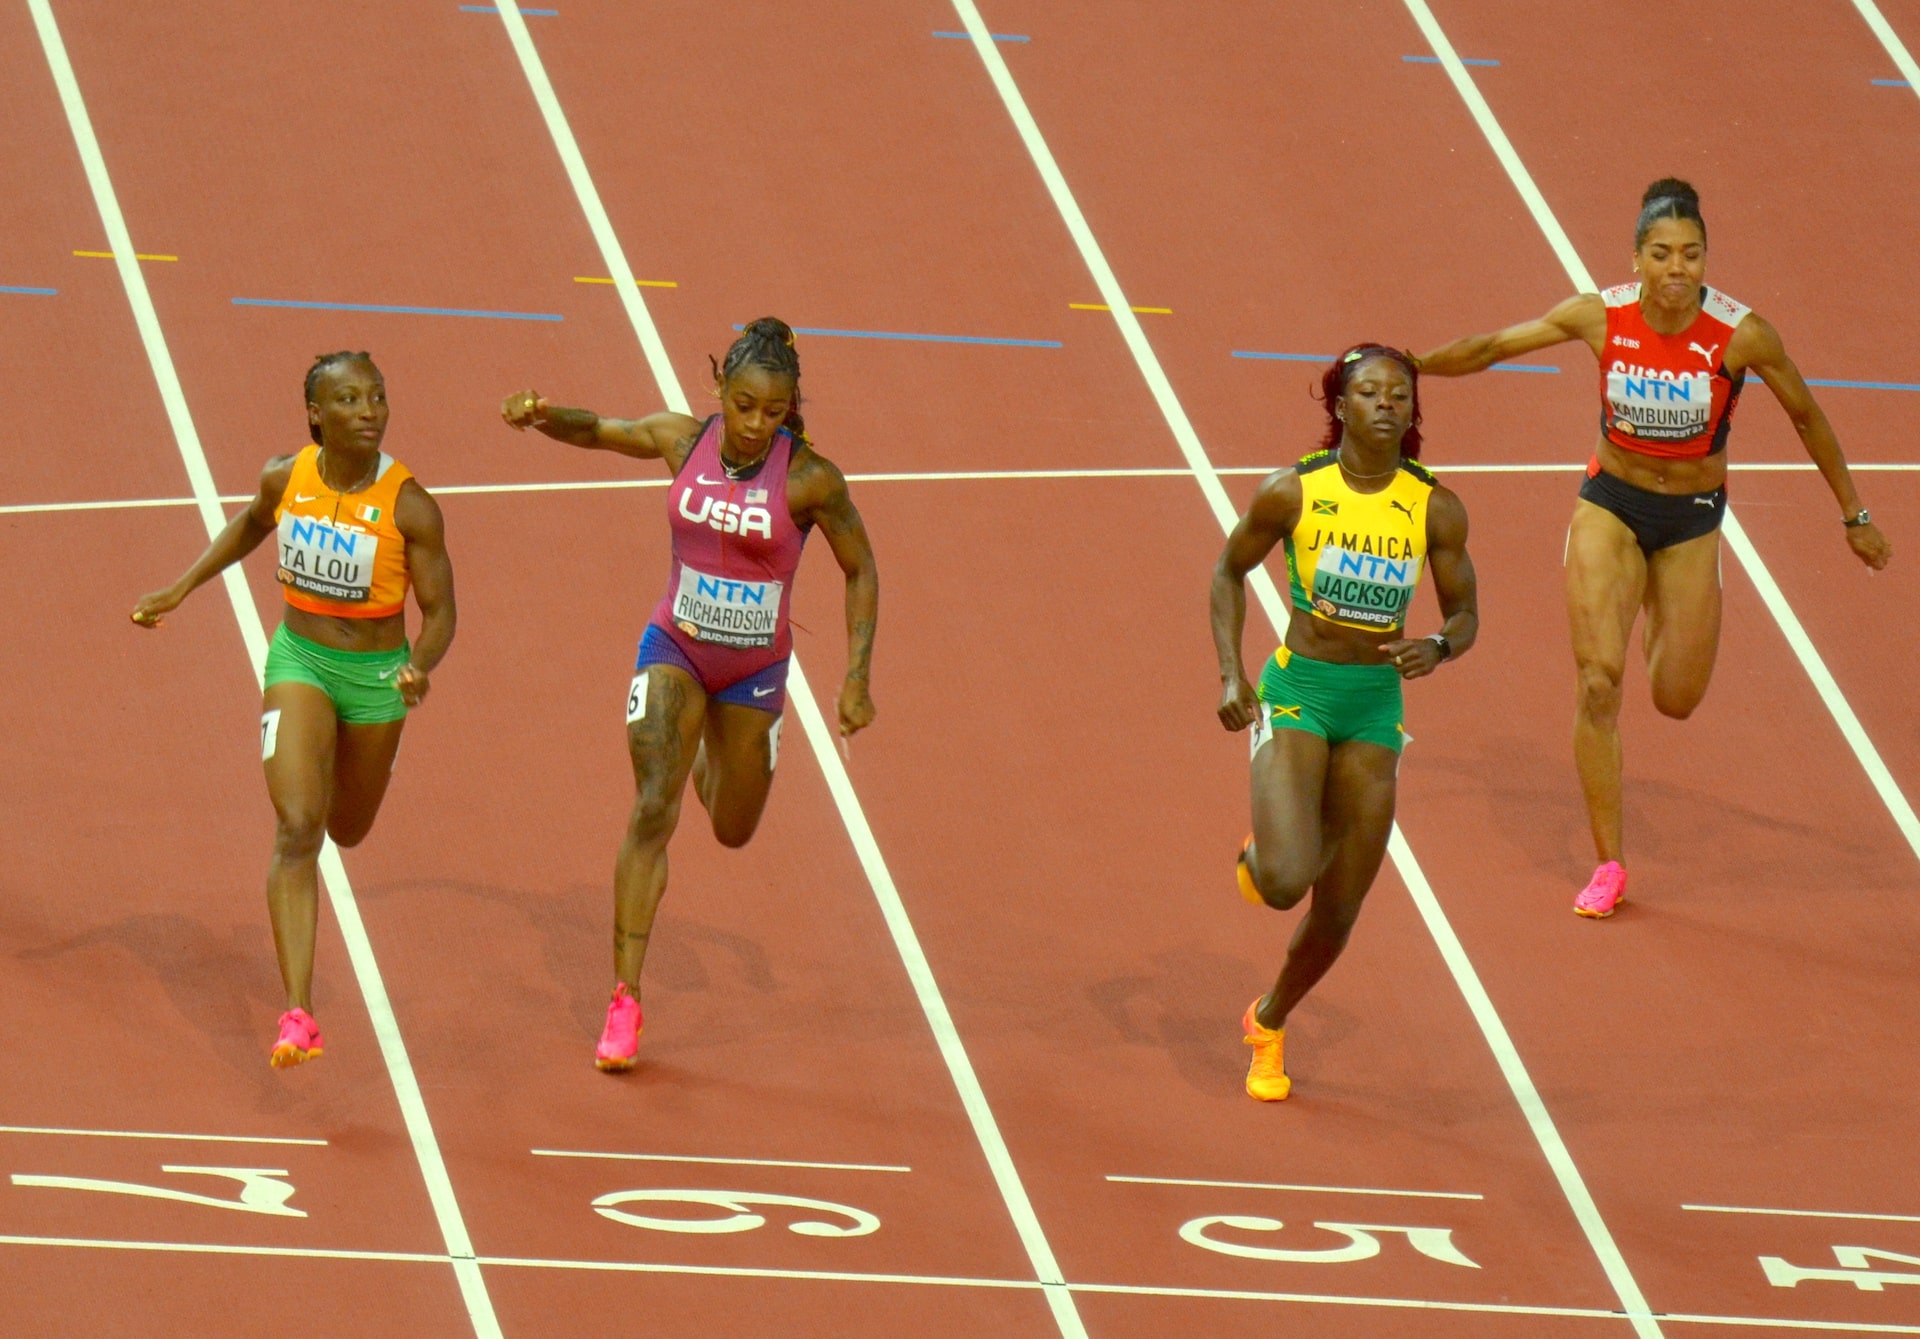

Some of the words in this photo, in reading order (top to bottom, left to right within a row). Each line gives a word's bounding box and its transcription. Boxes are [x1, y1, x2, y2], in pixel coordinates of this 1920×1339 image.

[1622, 338, 1641, 350] UBS
[1625, 376, 1691, 402] NTN
[1612, 400, 1705, 425] KAMBUNDJI
[1637, 426, 1692, 438] BUDAPEST
[678, 487, 772, 540] USA
[291, 518, 357, 558] NTN
[1308, 529, 1413, 561] JAMAICA
[283, 543, 306, 572] TA
[314, 555, 359, 584] LOU
[1338, 551, 1407, 584] NTN
[295, 576, 350, 598] BUDAPEST
[350, 588, 364, 599] 23
[697, 575, 766, 605] NTN
[1318, 575, 1410, 609] JACKSON
[678, 594, 774, 631] RICHARDSON
[1338, 608, 1394, 624] BUDAPEST
[700, 630, 756, 646] BUDAPEST
[628, 683, 639, 715] 6
[590, 1188, 880, 1238] 6
[1178, 1215, 1483, 1269] 5
